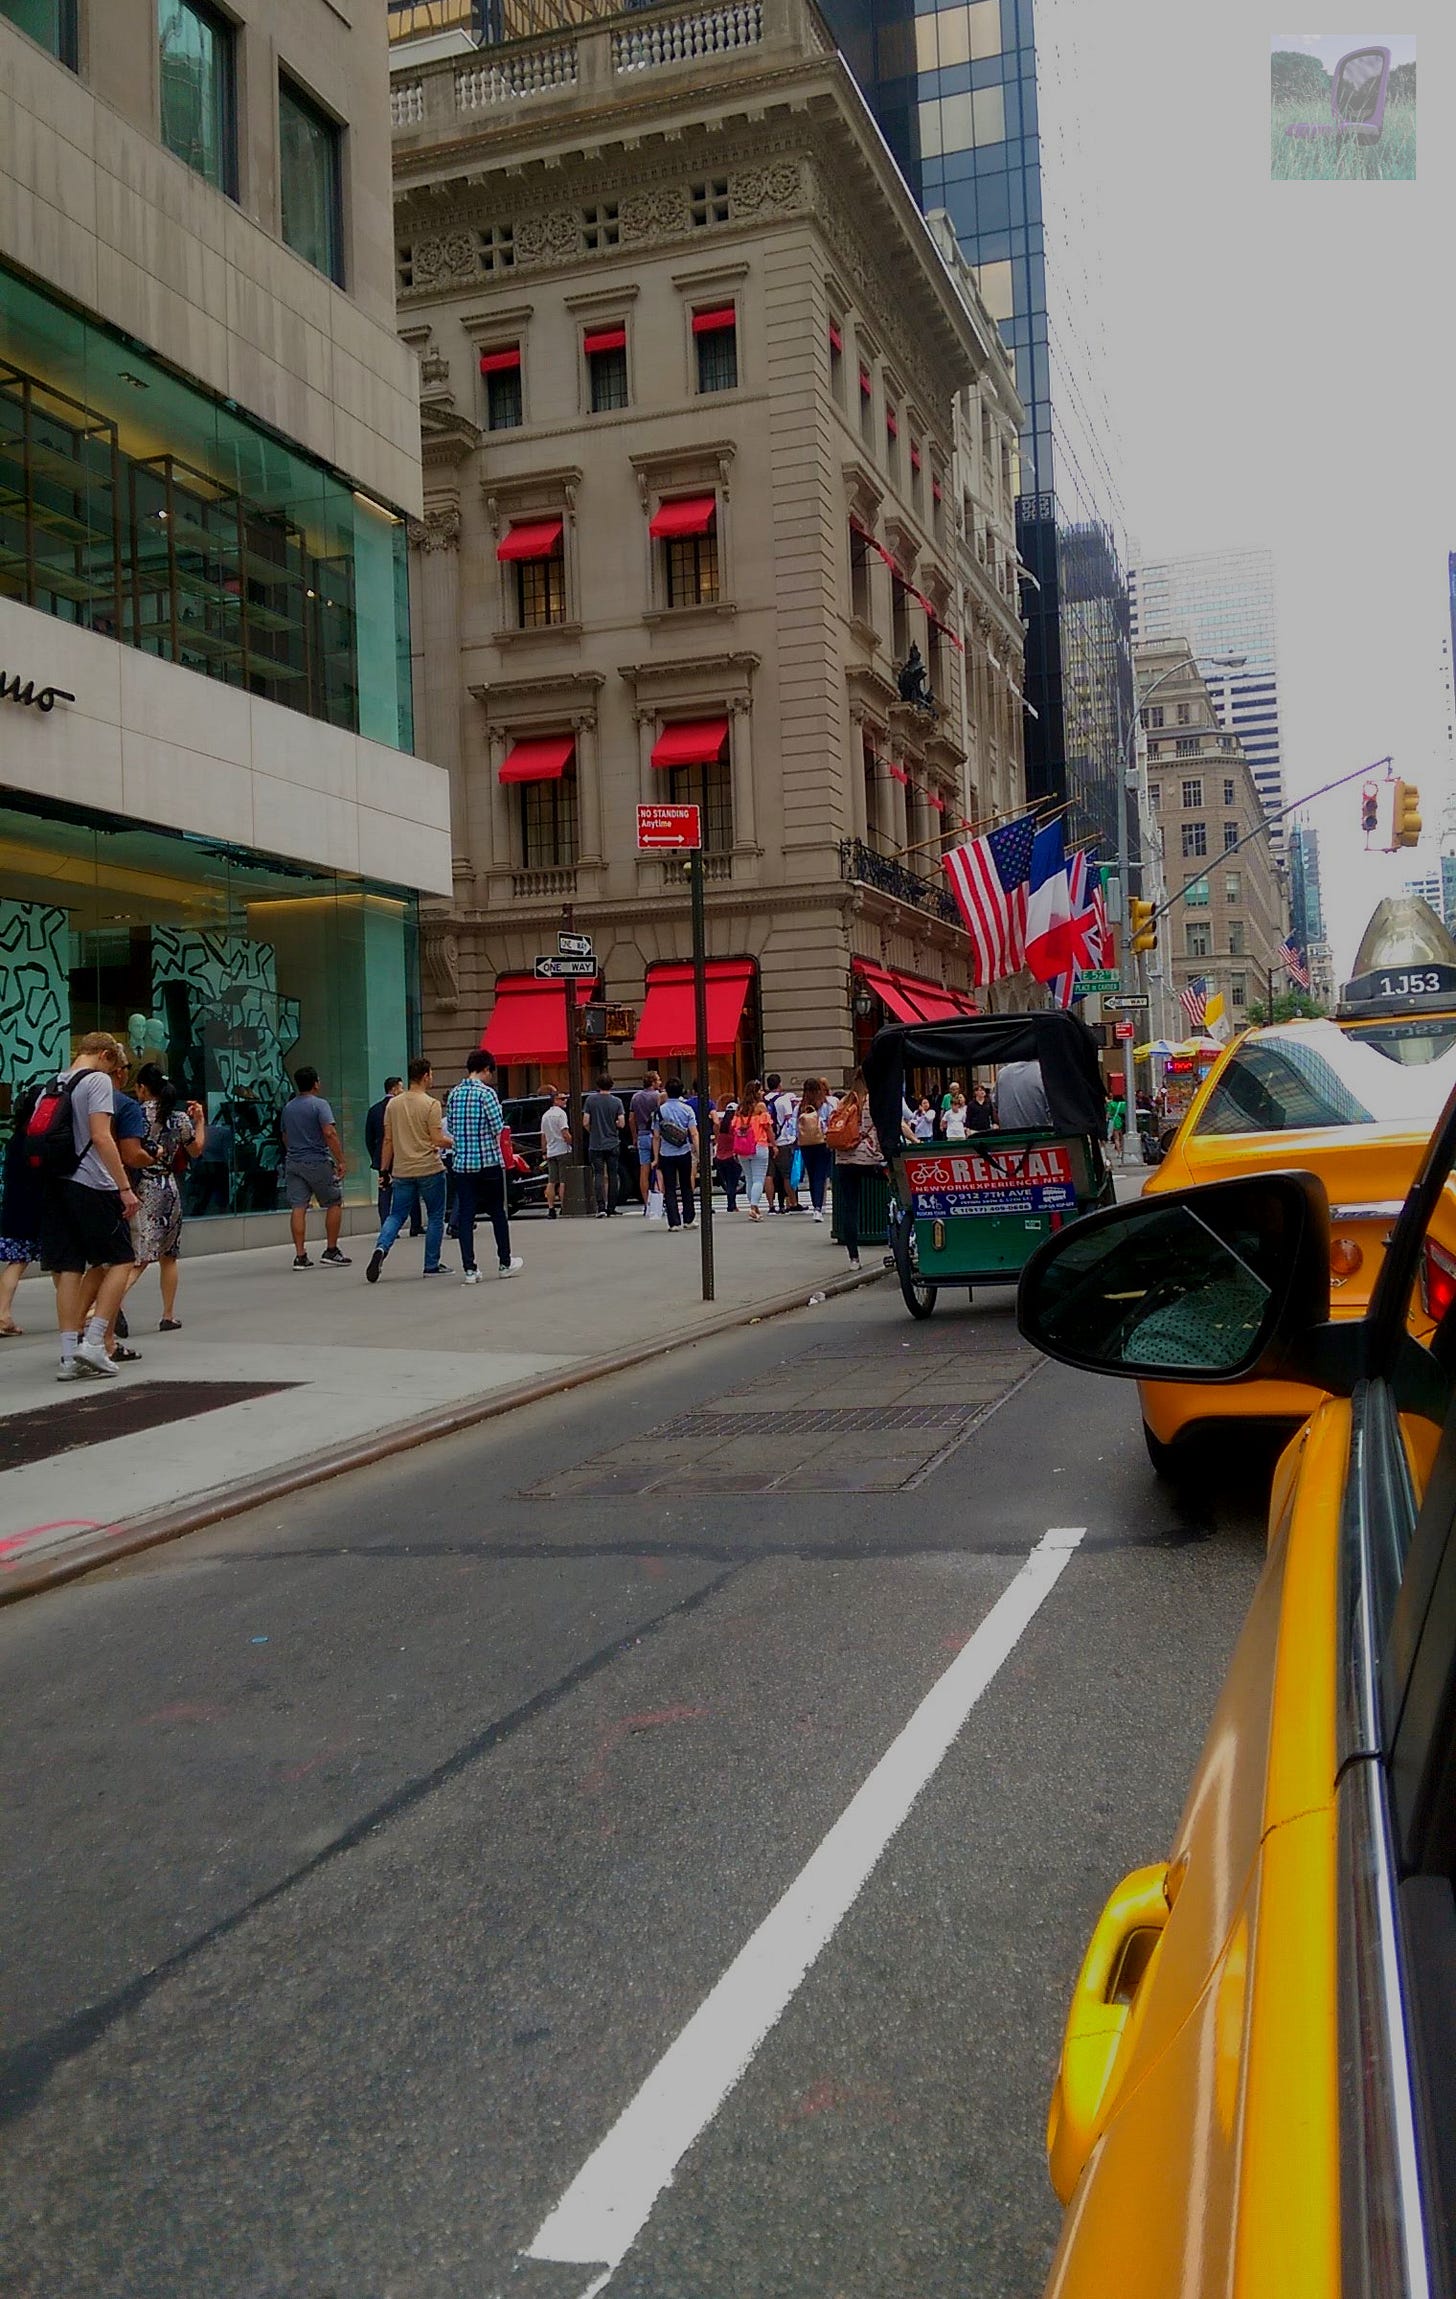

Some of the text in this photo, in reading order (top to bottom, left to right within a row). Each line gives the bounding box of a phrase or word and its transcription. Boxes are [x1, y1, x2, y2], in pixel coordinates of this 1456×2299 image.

[640, 808, 690, 818] NO STANDING
[641, 819, 672, 829] Anytime
[543, 963, 591, 972] ONE WAY
[1082, 971, 1089, 980] E
[1091, 970, 1105, 980] 52
[1380, 972, 1440, 996] 1J53
[950, 1151, 1064, 1184] RENTAL
[958, 1189, 1032, 1200] 912 7TH AVE
